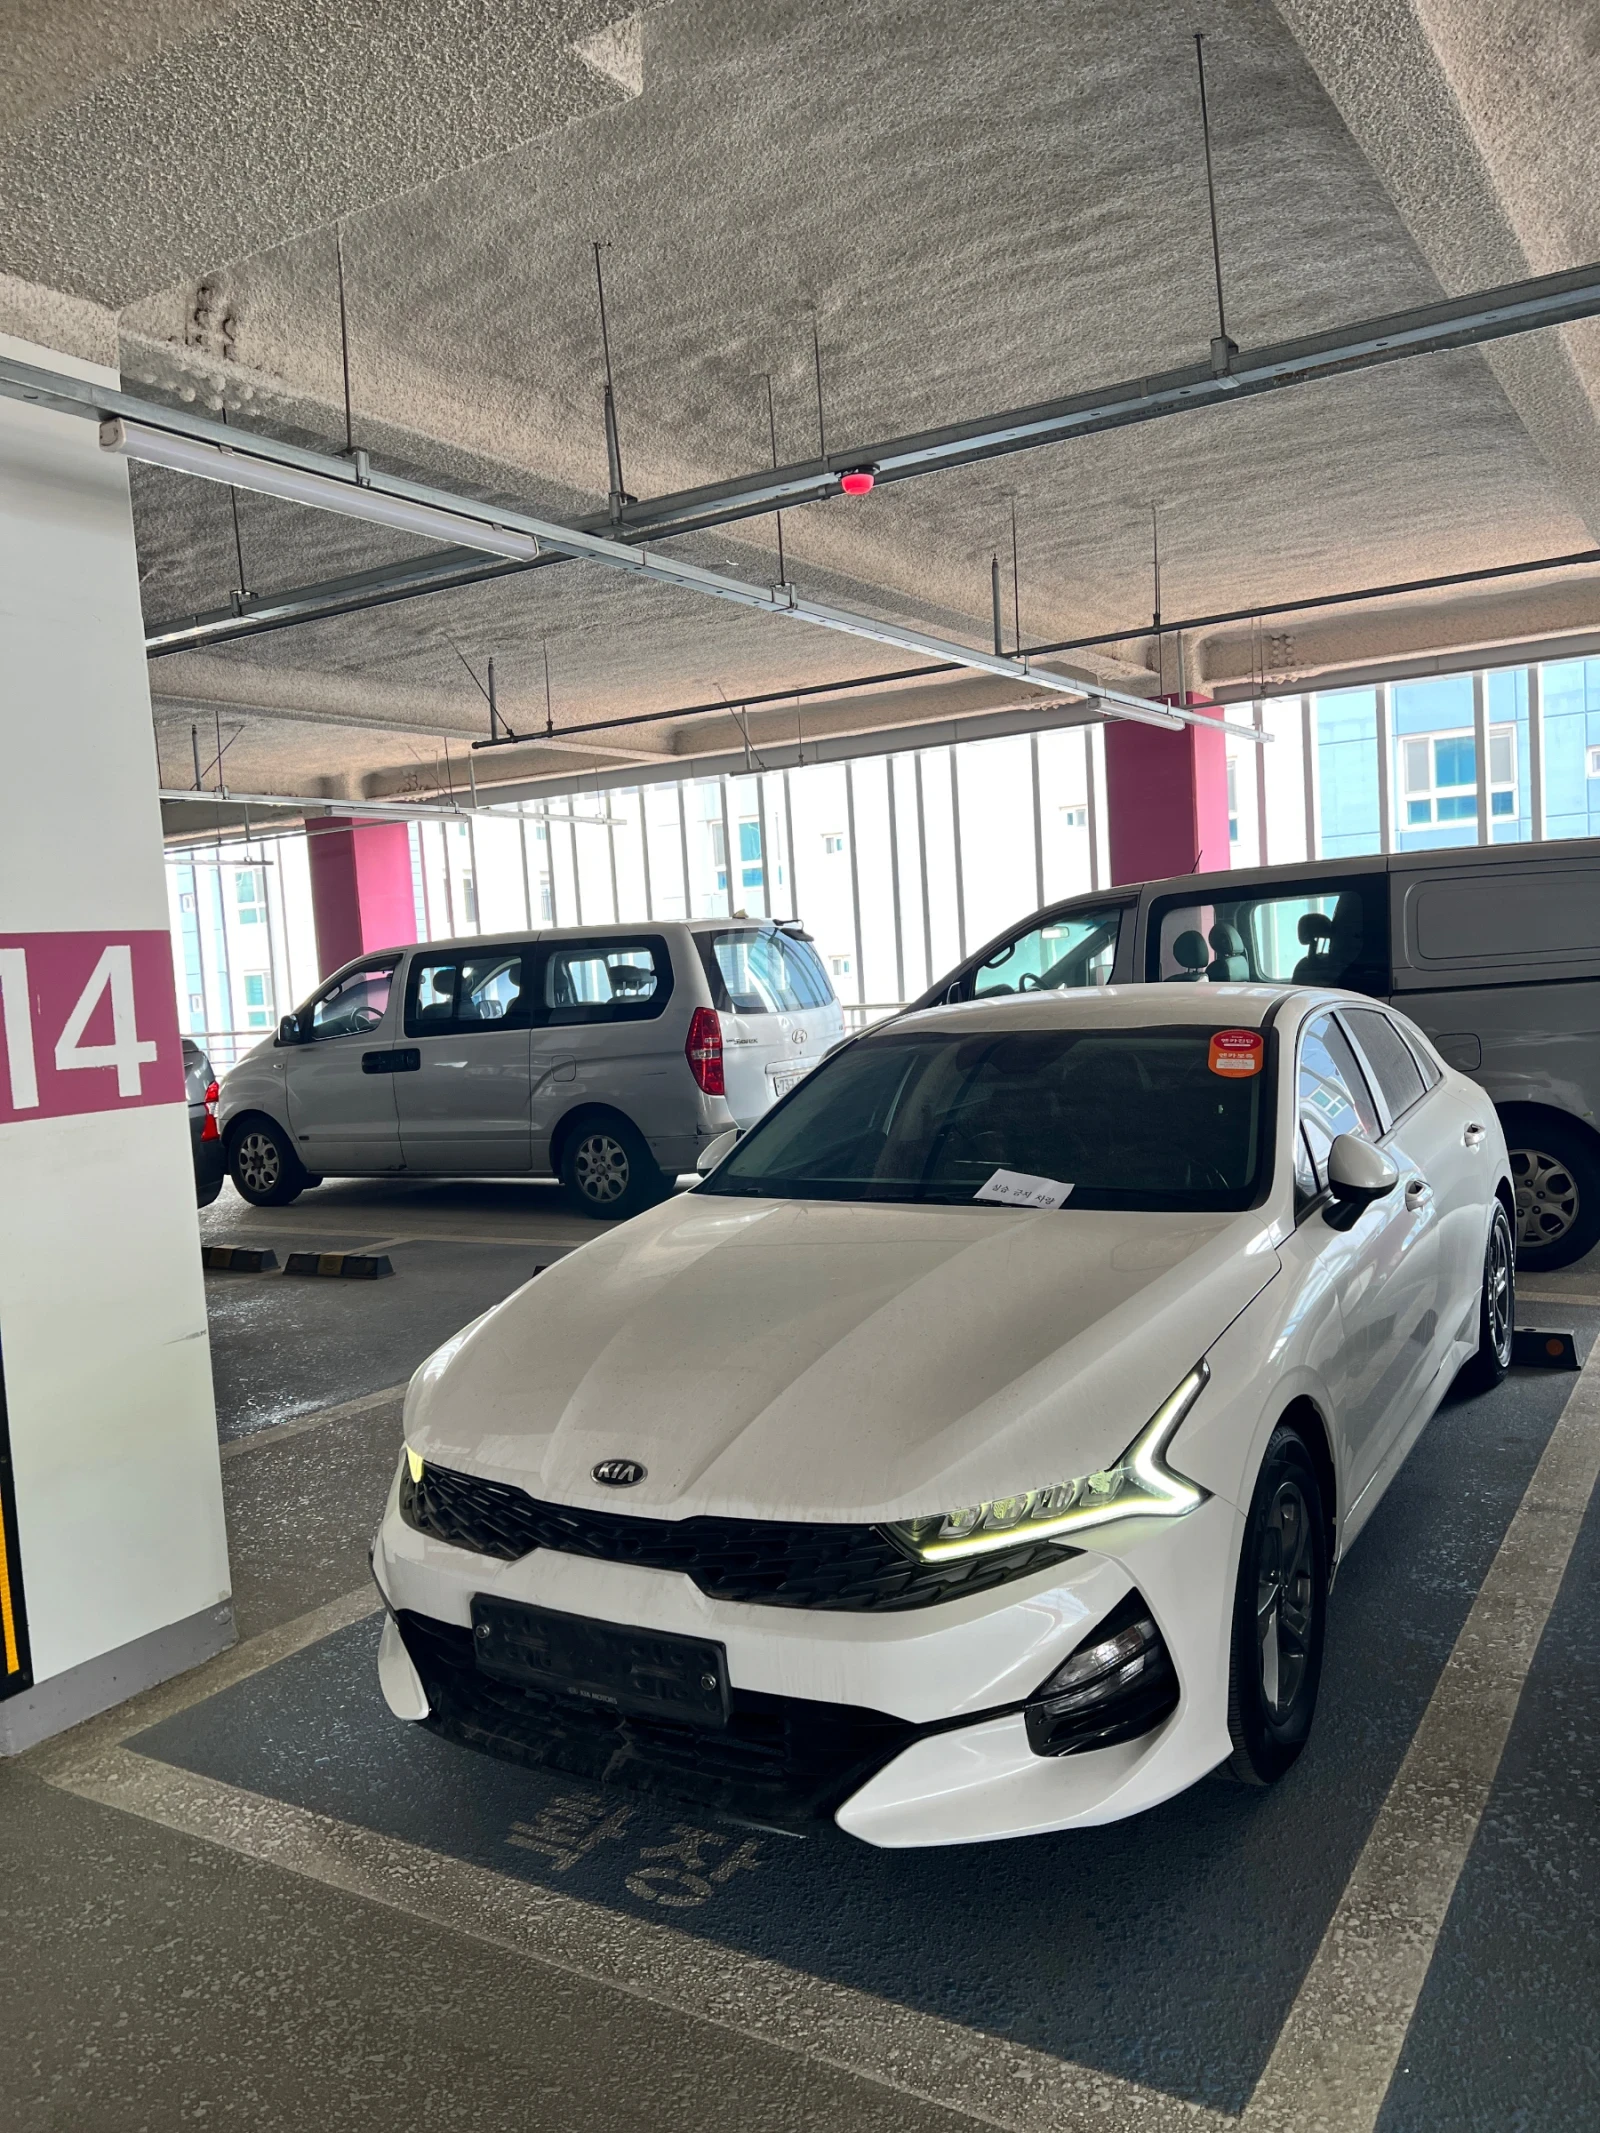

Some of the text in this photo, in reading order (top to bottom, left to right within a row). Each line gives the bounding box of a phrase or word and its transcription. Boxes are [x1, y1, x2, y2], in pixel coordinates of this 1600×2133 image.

[1013, 1188, 1032, 1198] 금지
[1035, 1193, 1056, 1205] 차량
[597, 1462, 636, 1482] KIA
[591, 1692, 618, 1704] MOTORS
